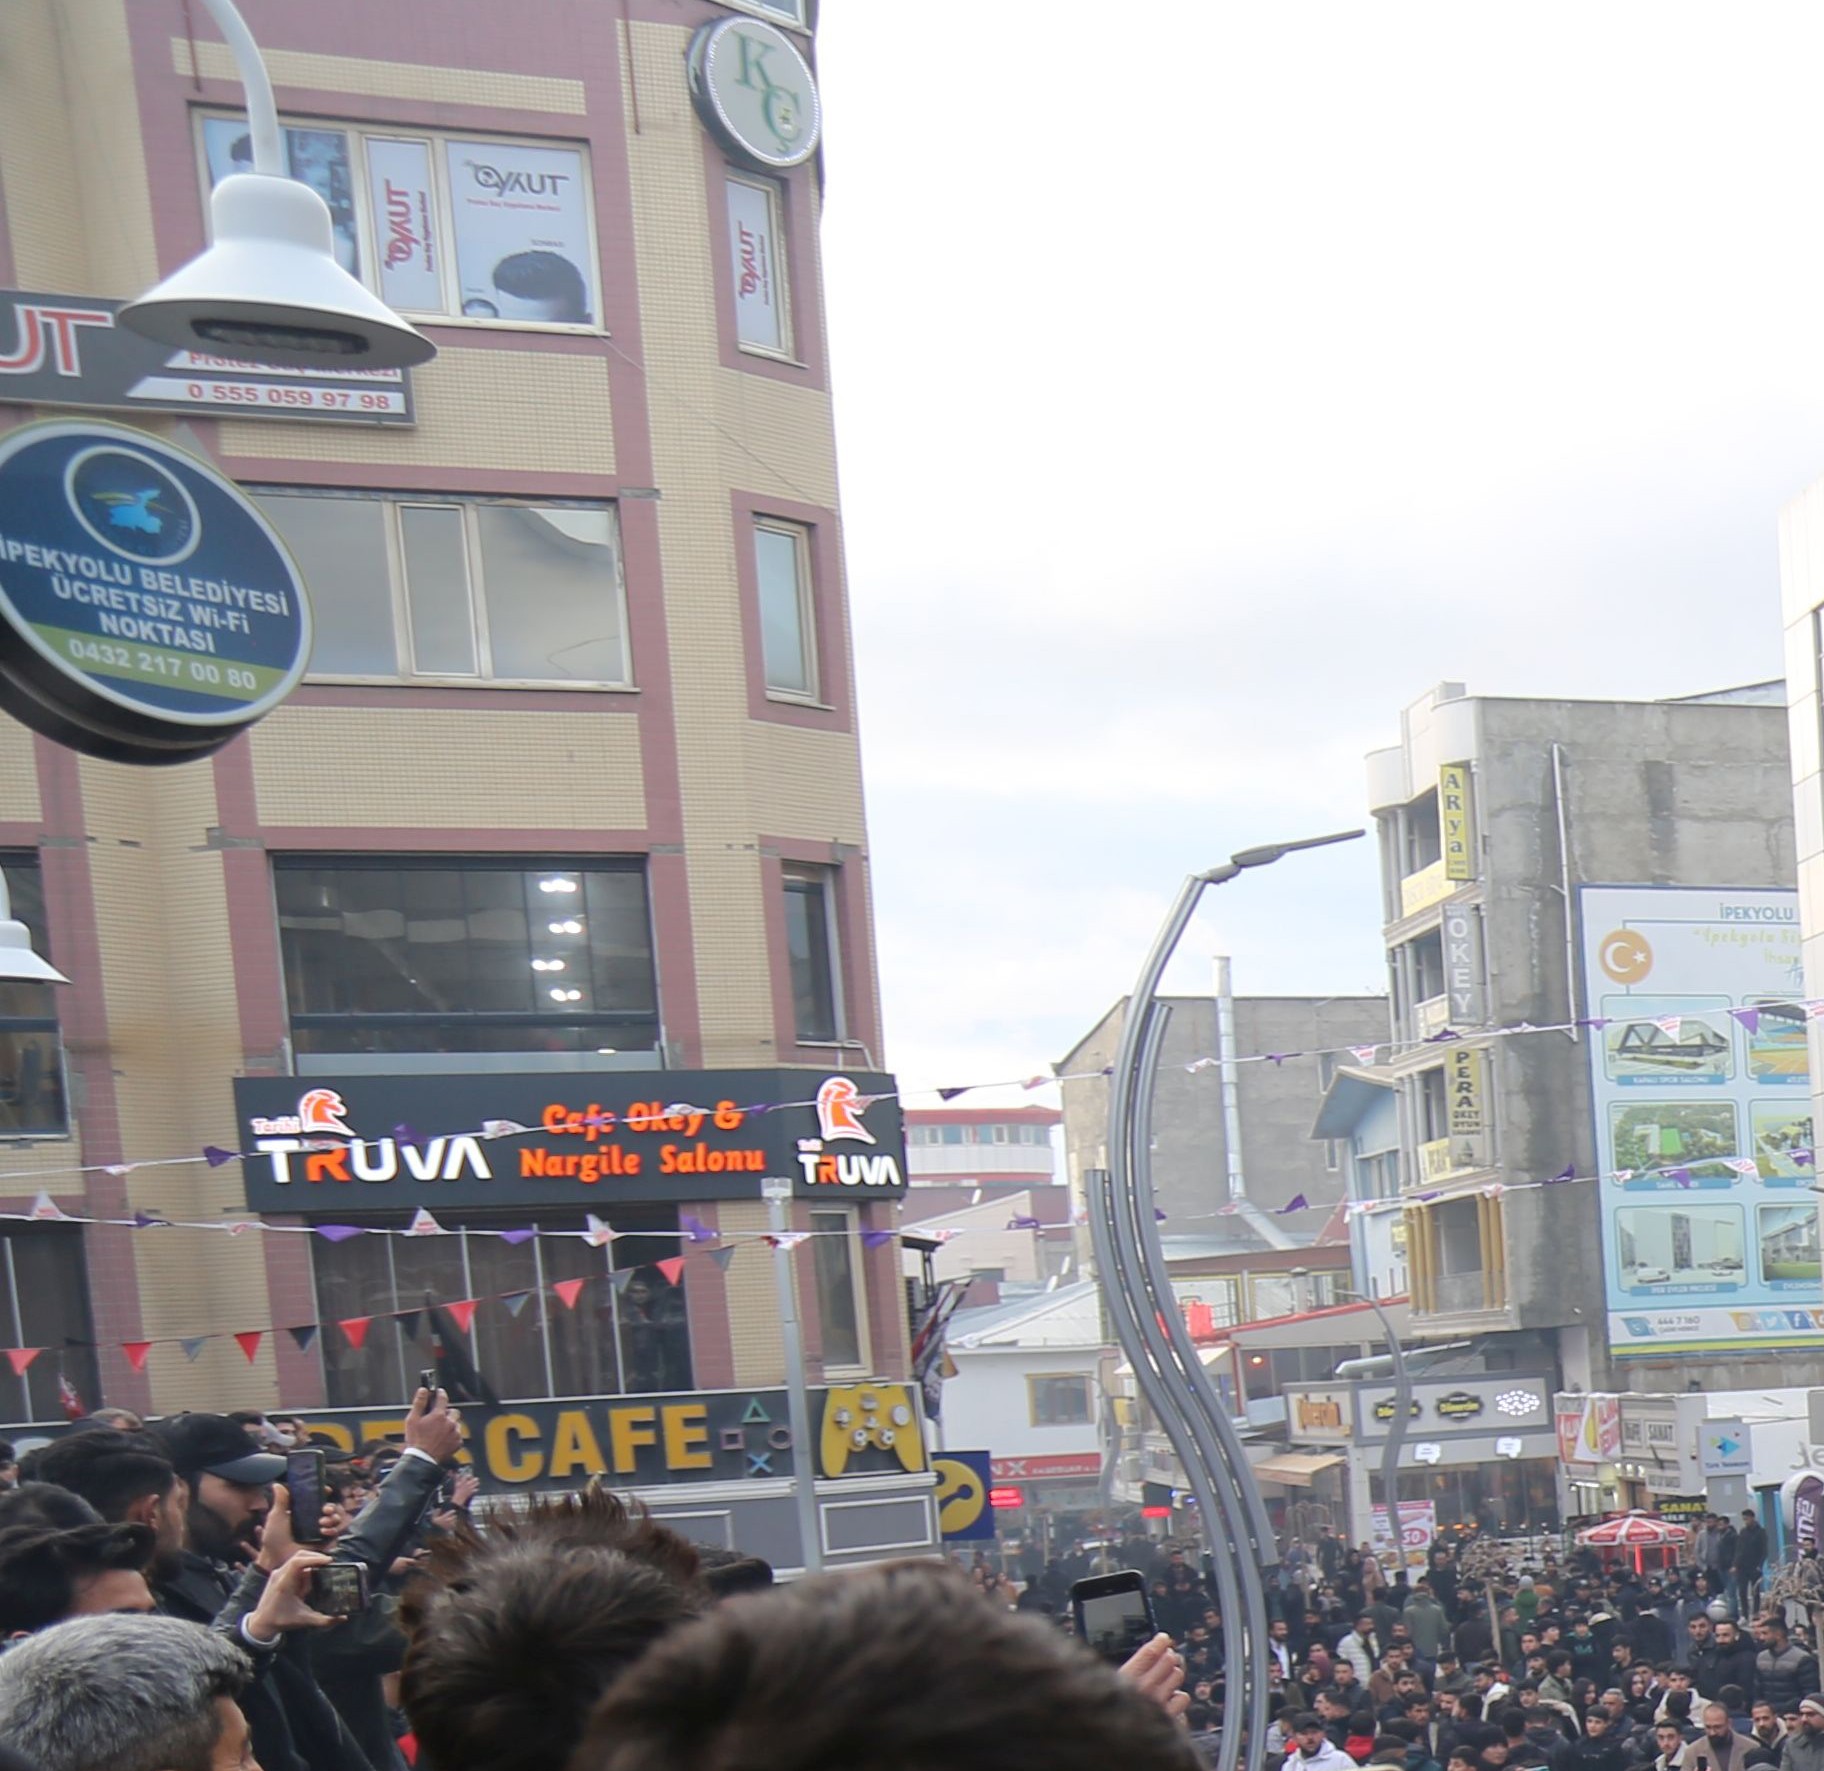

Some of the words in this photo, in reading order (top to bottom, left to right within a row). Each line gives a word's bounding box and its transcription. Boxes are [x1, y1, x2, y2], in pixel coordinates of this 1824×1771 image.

[188, 384, 203, 400] 0
[213, 385, 259, 402] 555
[269, 388, 313, 406] 059
[322, 391, 350, 408] 97
[361, 394, 390, 410] 98
[140, 567, 290, 617] BELEDİYESİ
[98, 611, 216, 653] NOKTASI
[190, 608, 251, 635] Wi-Fi
[68, 638, 132, 669] 0432
[139, 653, 182, 677] 217
[190, 662, 221, 683] 00
[227, 668, 257, 690] 80
[1719, 902, 1794, 921] İPEKYOLU
[1447, 917, 1473, 1013] OKEY
[1455, 1051, 1474, 1108] PERA
[626, 1101, 704, 1137] Okey
[713, 1100, 745, 1131] &
[519, 1145, 642, 1184] Nargile
[658, 1141, 766, 1175] Salonu
[796, 1152, 902, 1187] TRUVA
[485, 1404, 714, 1483] CAFE
